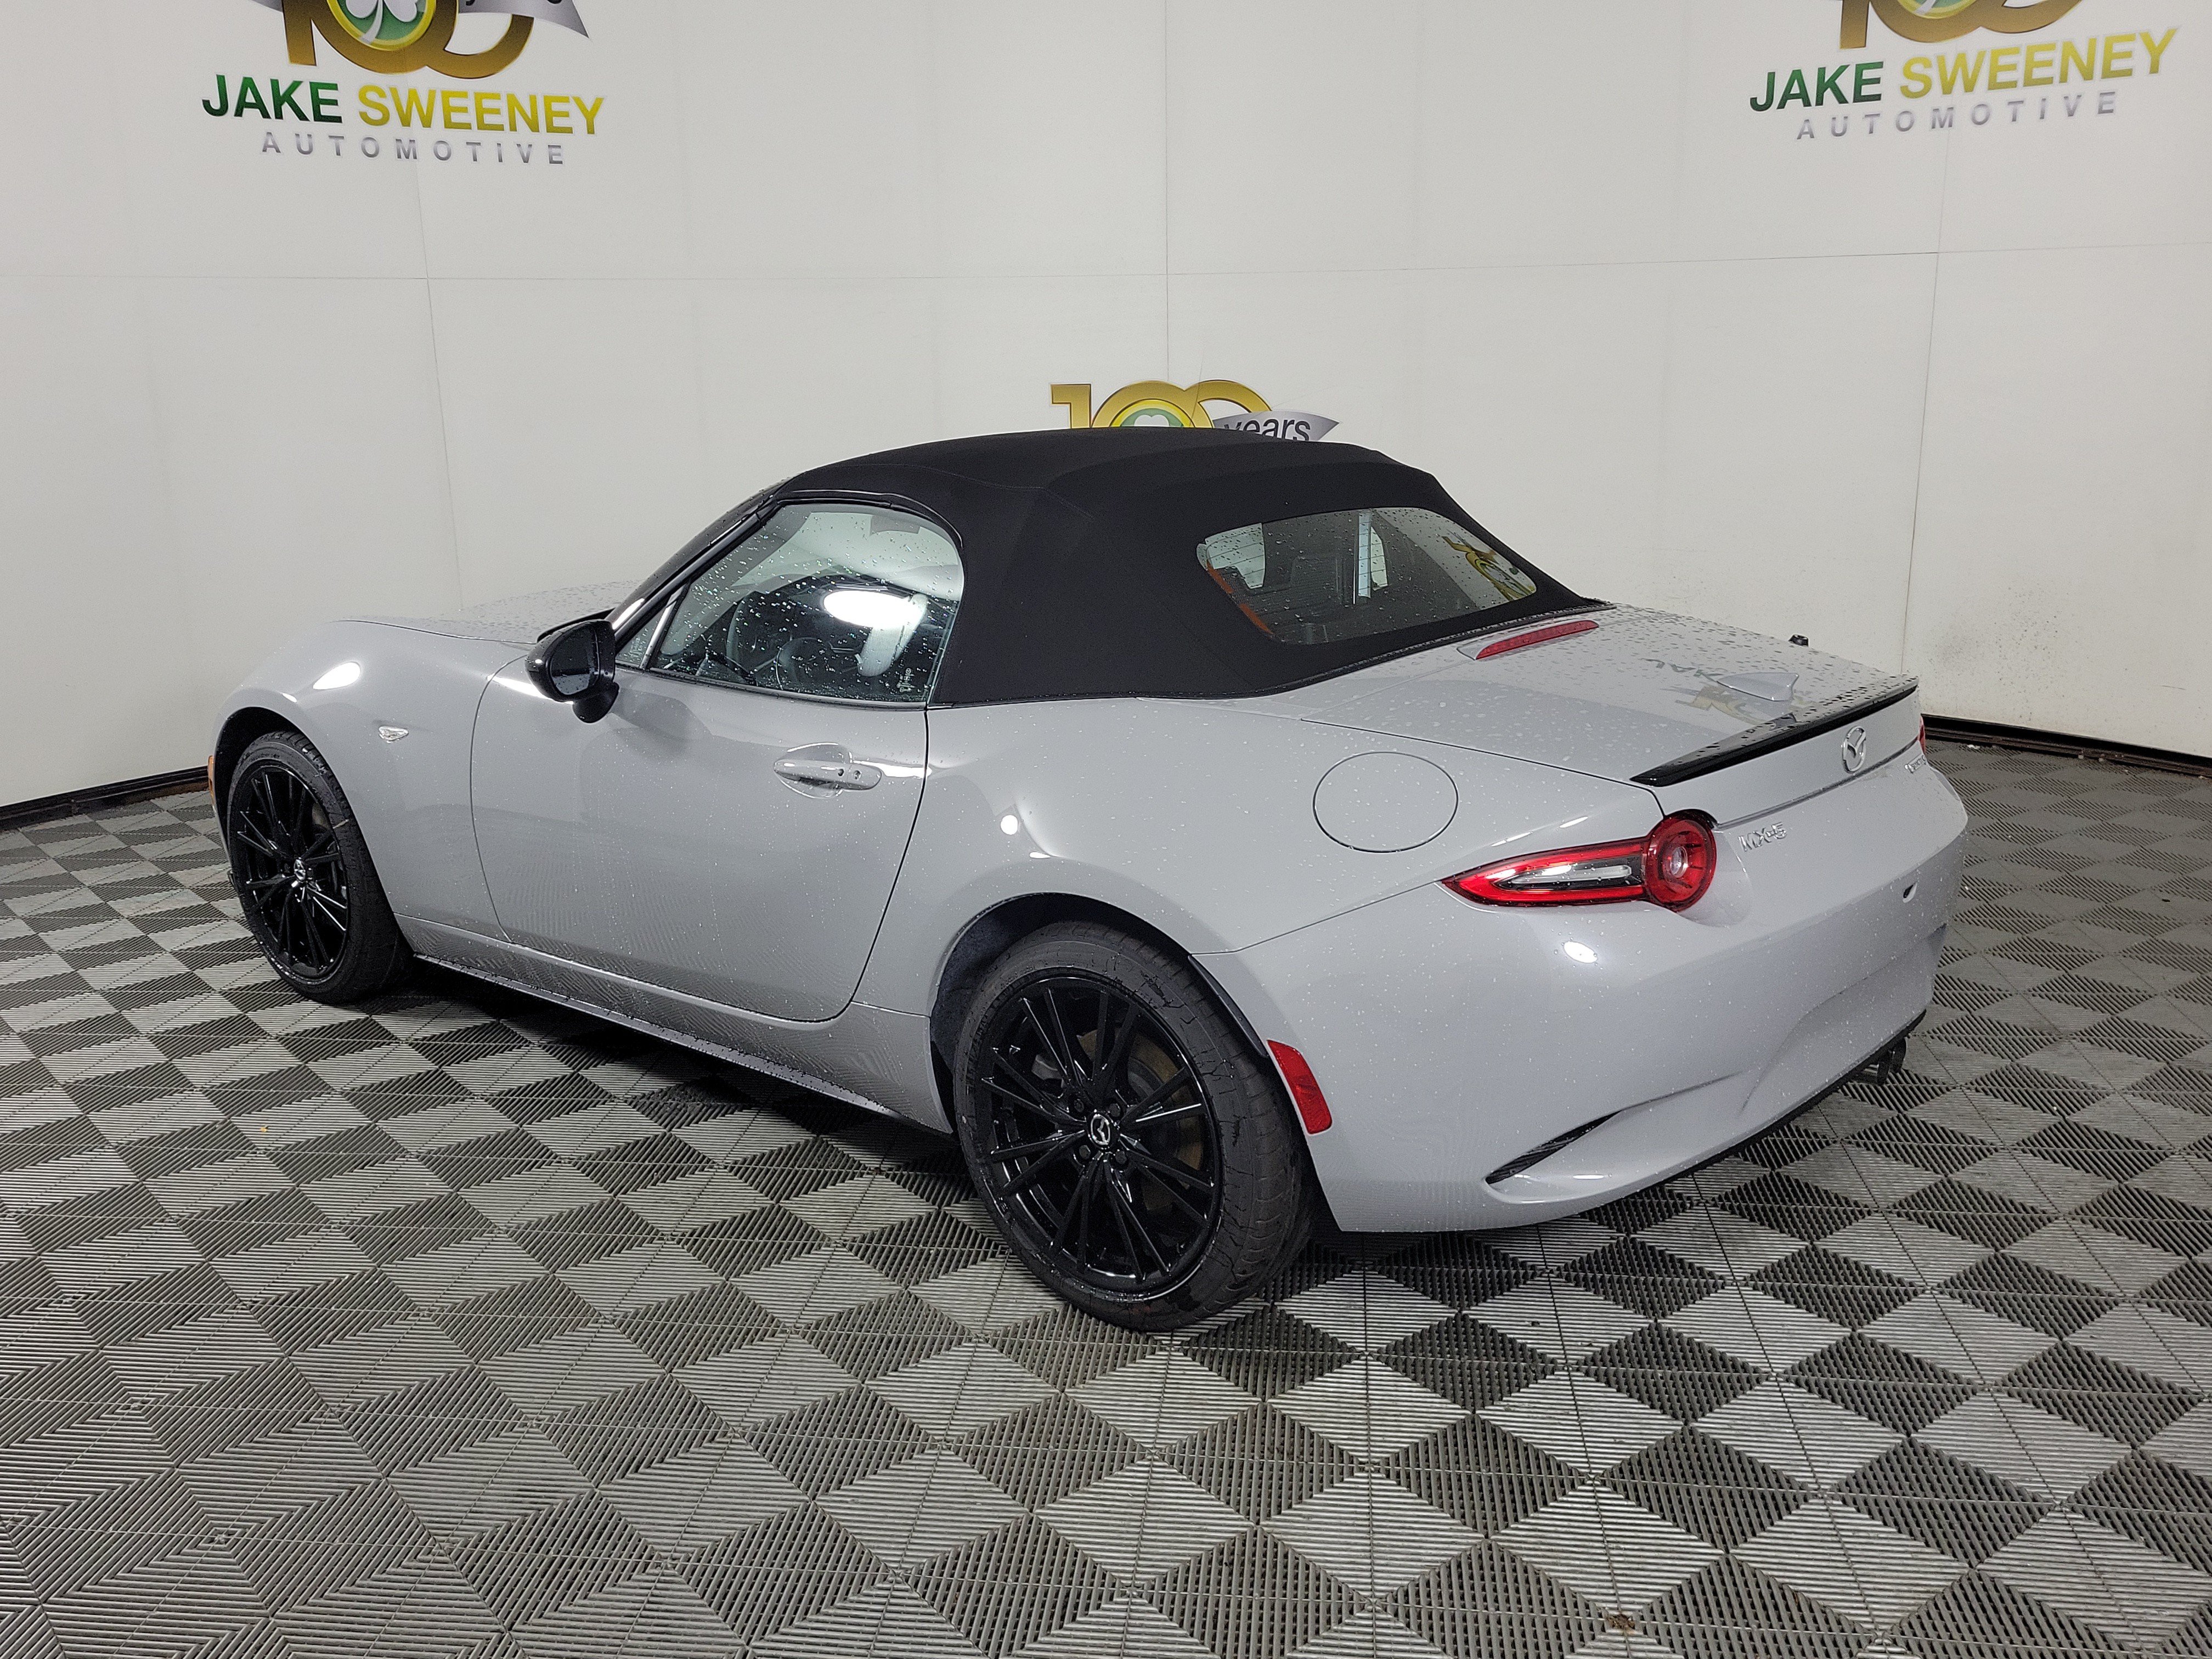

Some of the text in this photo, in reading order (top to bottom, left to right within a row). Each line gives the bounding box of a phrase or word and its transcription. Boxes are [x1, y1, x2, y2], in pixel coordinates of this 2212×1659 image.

[1750, 29, 2178, 112] JAKE SWEENEY
[202, 74, 604, 135] JAKE SWEENEY
[1796, 92, 2116, 140] AUTOMOTIVE
[262, 132, 563, 165] AUTOMOTIVE
[1224, 419, 1311, 441] ears
[1738, 822, 1787, 852] MX-5
